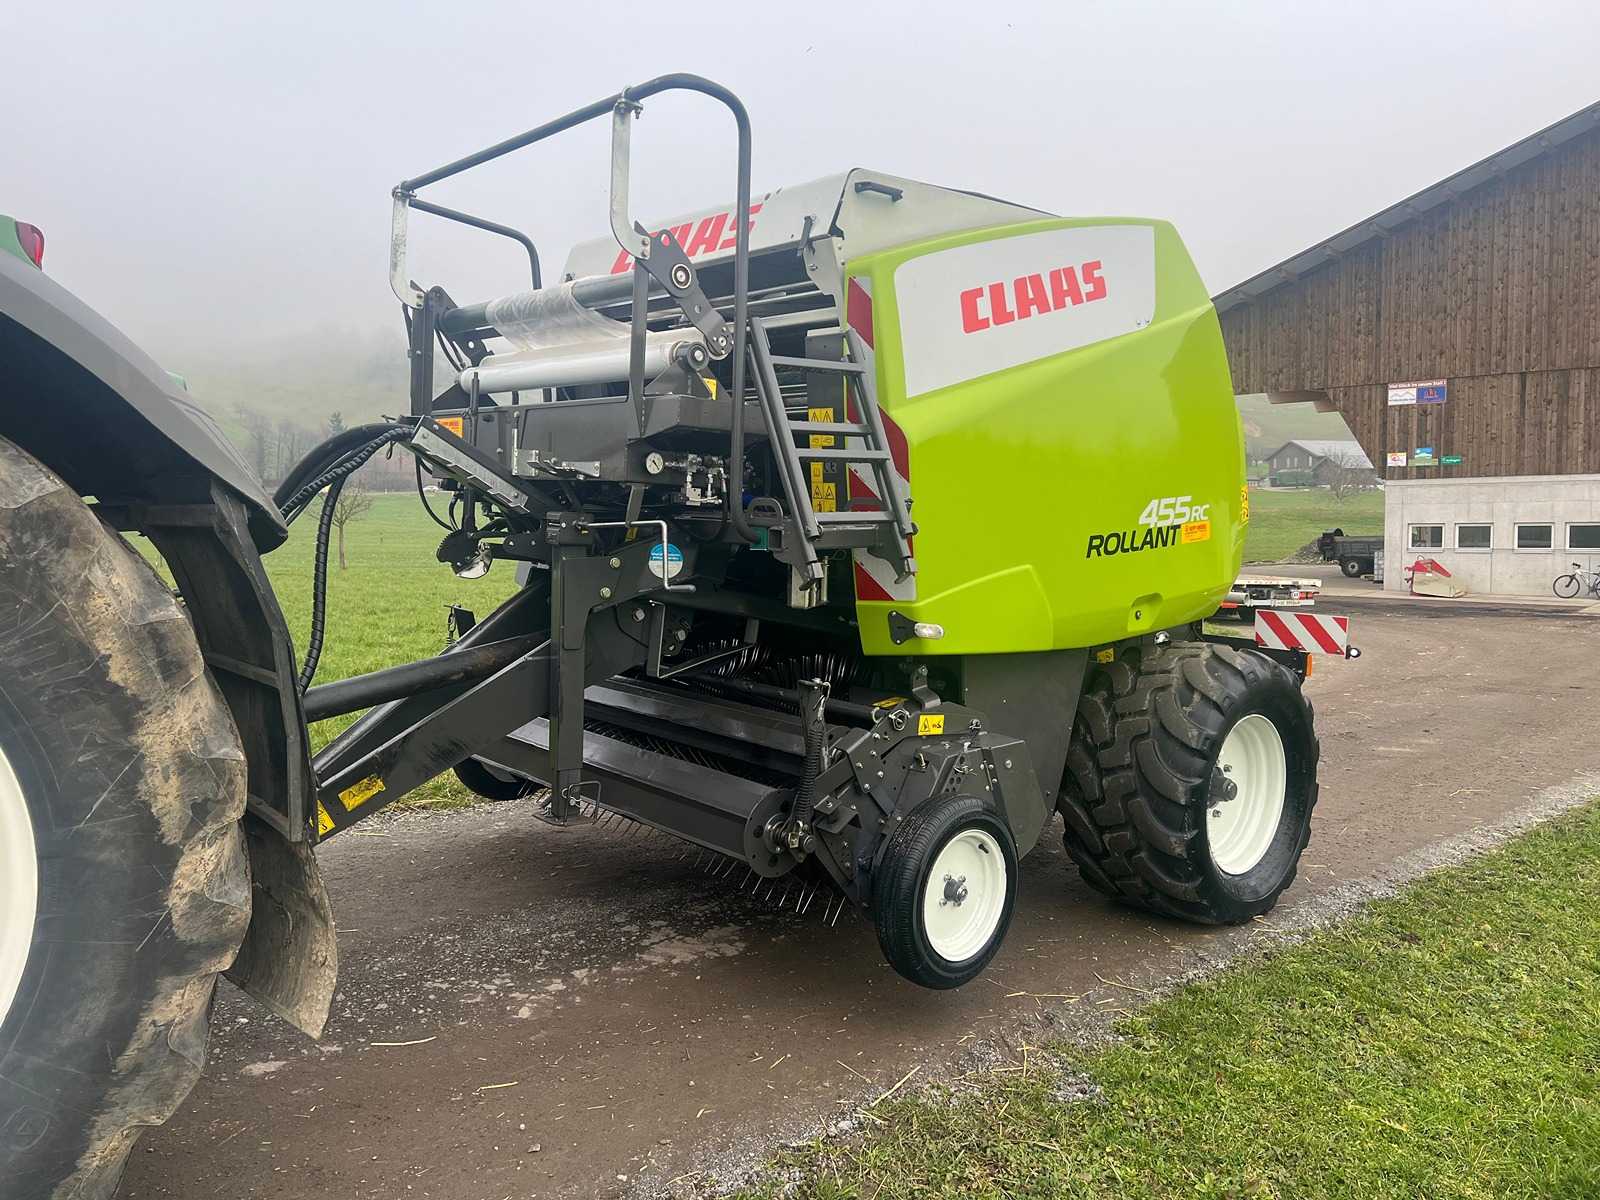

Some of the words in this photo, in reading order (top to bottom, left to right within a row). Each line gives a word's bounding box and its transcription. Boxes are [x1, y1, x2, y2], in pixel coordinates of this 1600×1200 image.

[610, 203, 764, 275] CAAS
[960, 260, 1107, 334] CLAAS
[1086, 524, 1181, 559] ROLLANT
